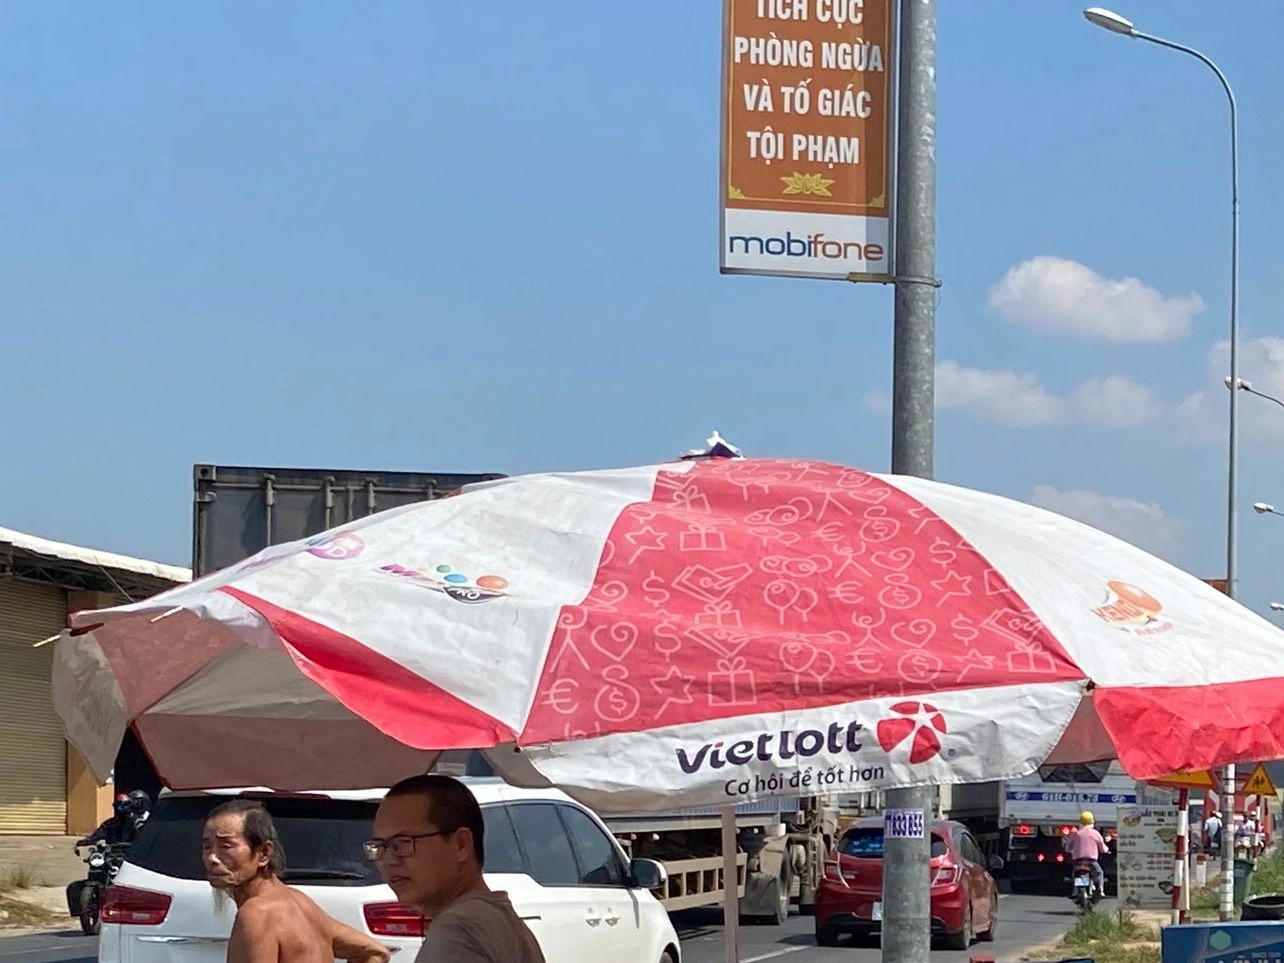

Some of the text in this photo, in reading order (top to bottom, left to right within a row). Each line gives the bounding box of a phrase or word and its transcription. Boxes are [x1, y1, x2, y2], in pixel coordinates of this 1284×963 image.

[734, 32, 885, 73] PHÒNG NGỪA
[743, 78, 873, 119] VÀ TỐ GIÁC
[746, 125, 860, 169] TỘI PHẠM
[729, 231, 884, 261] mobifone
[725, 763, 885, 797] Cơ hội để tốt hơn
